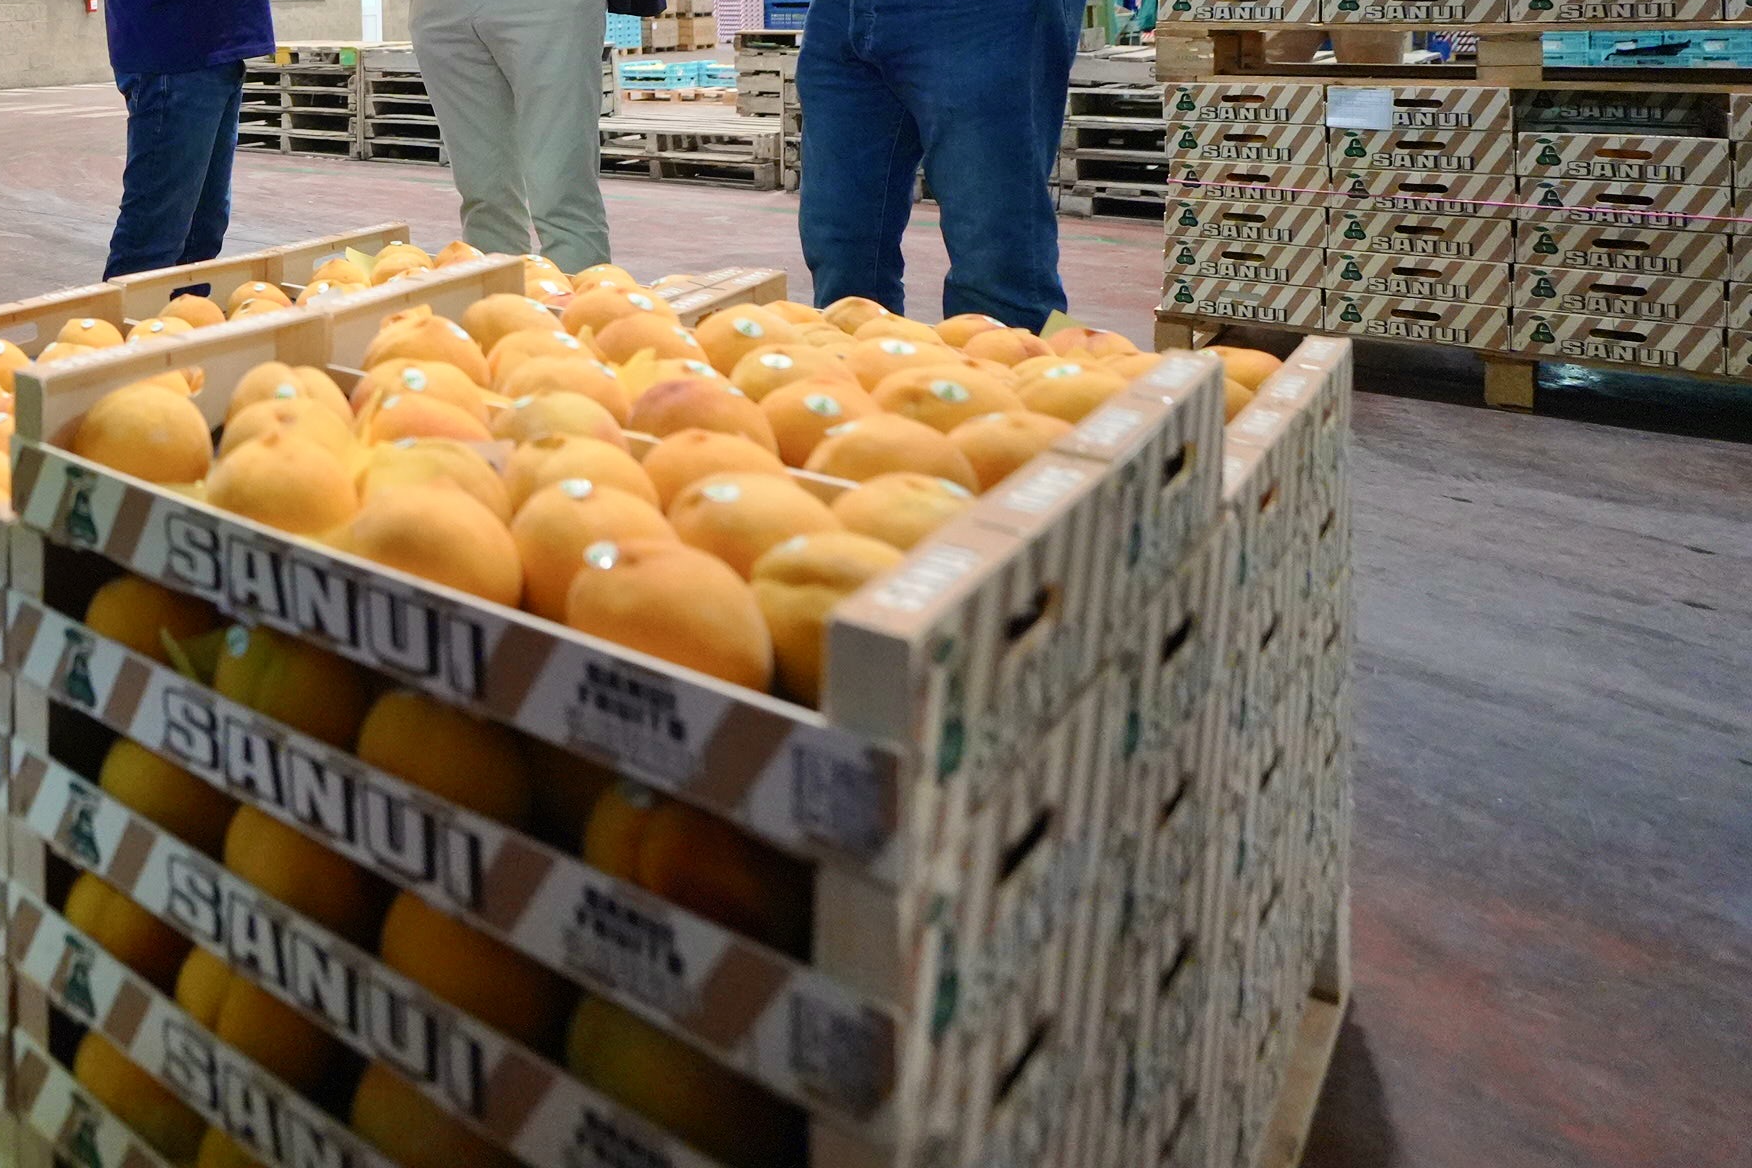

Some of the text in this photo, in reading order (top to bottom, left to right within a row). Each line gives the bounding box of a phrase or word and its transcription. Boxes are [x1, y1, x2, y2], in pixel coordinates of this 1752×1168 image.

[1196, 6, 1284, 21] SANUI
[1365, 4, 1466, 20] SANUI
[1558, 2, 1677, 19] SANUI
[1200, 107, 1289, 122] SANUI
[1392, 110, 1473, 128] ANUI
[1559, 104, 1664, 121] SANUI
[1202, 145, 1291, 162] SANUI
[1372, 152, 1474, 171] SANUI
[1566, 160, 1687, 182] SANUI
[1206, 184, 1296, 203] SANUI
[1375, 196, 1478, 214] SANUI
[1569, 206, 1689, 228] SANUI
[1203, 223, 1292, 243] SANUI
[1371, 235, 1474, 257] SANUI
[1200, 261, 1289, 282] SANUI
[1564, 249, 1683, 274] SANUI
[1367, 276, 1470, 300] SANUI
[1199, 300, 1287, 322] SANUI
[1561, 293, 1680, 320] SANUI
[1366, 318, 1469, 343] SANUI
[1560, 339, 1680, 367] SANUI
[164, 513, 487, 699] SANUI
[162, 683, 484, 911] SANUI
[166, 852, 485, 1121] SANUI
[163, 1018, 354, 1168] SAN
